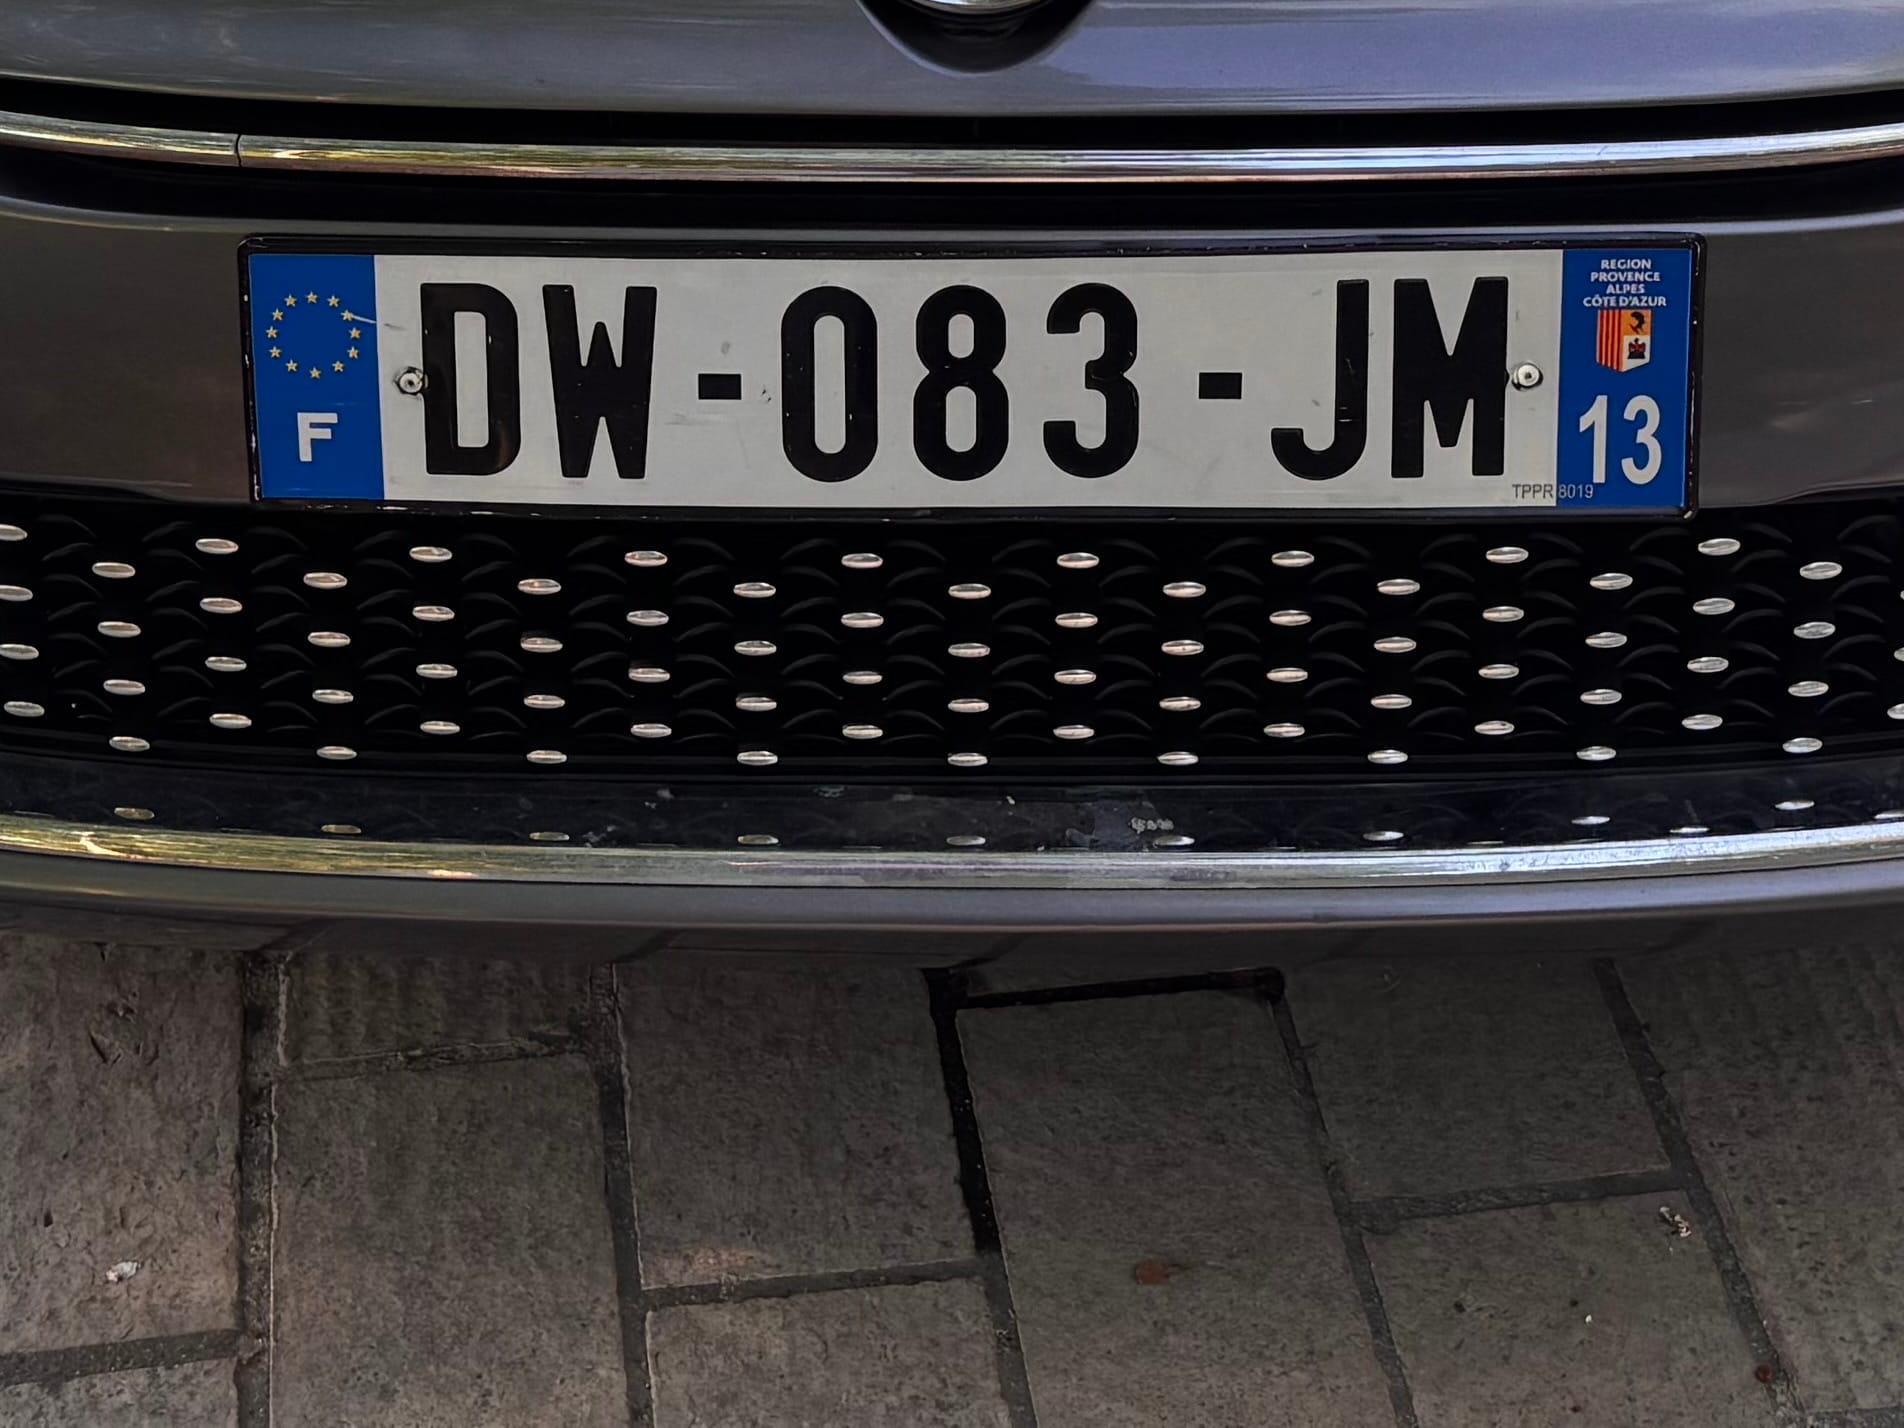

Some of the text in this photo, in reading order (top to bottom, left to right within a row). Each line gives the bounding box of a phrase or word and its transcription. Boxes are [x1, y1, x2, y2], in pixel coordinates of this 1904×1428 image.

[1590, 271, 1660, 282] PROVENCE
[1606, 284, 1645, 294] ALPES
[1583, 294, 1667, 307] CÔTE D'AZUR
[297, 412, 338, 462] F
[1579, 395, 1662, 484] 13
[1512, 484, 1594, 498] TPPR 8019
